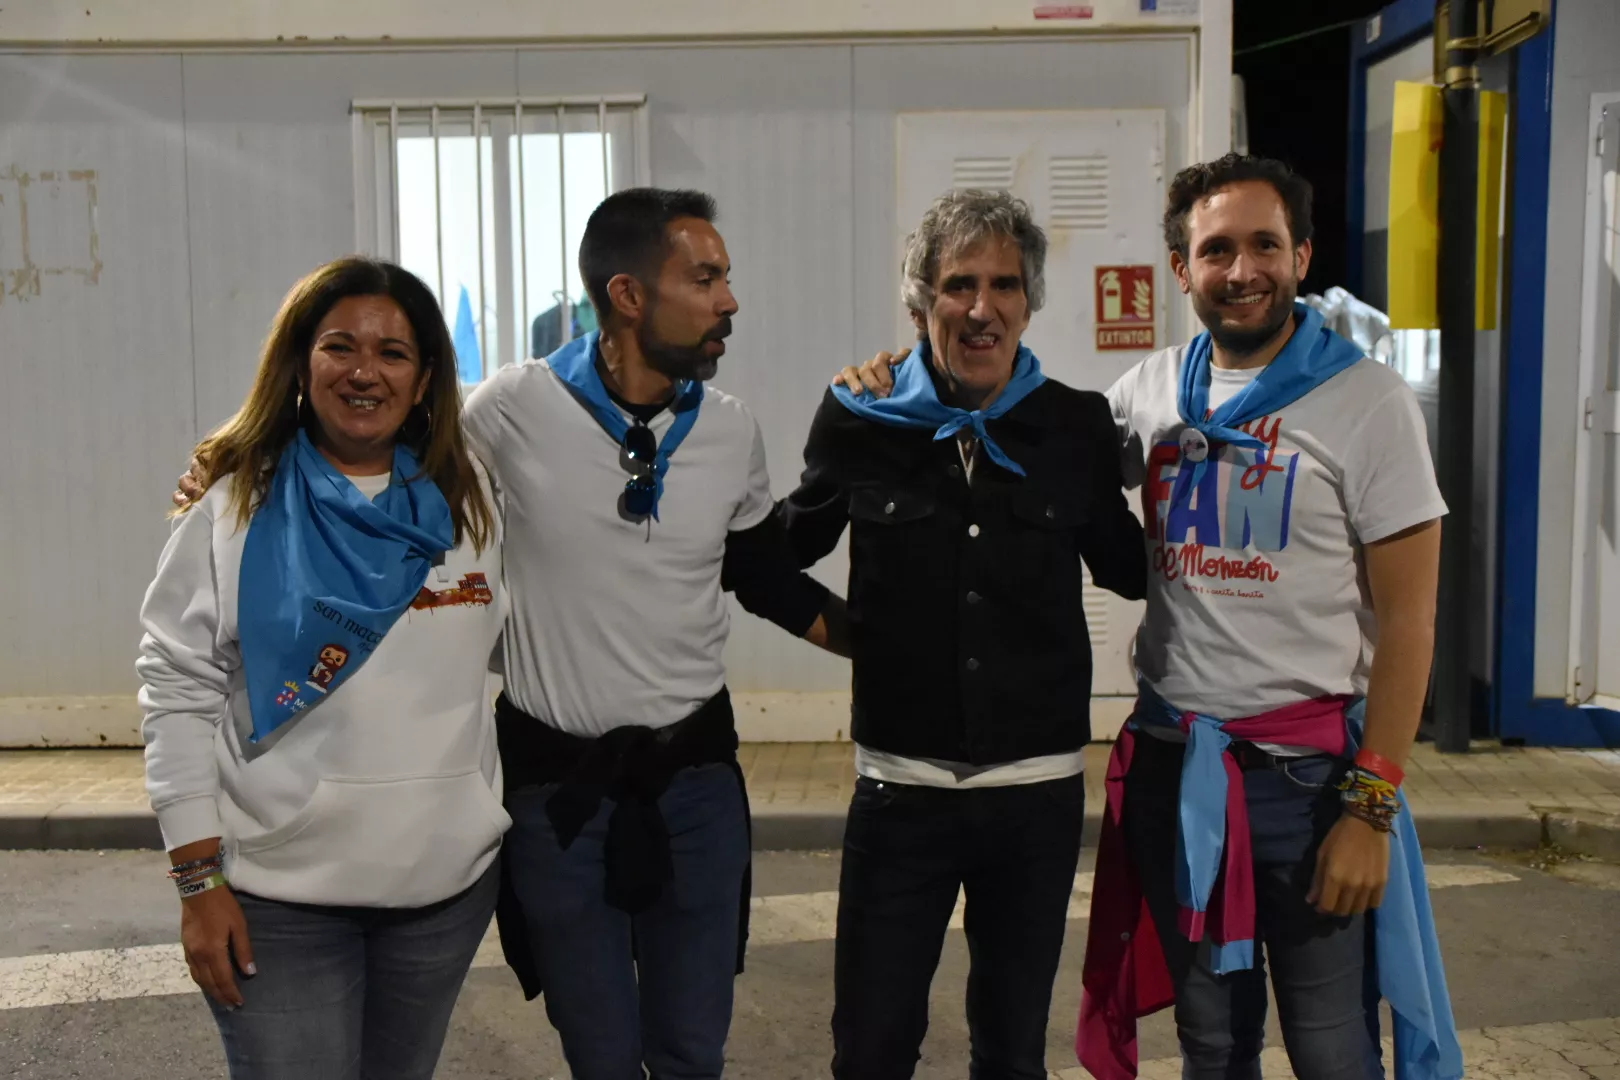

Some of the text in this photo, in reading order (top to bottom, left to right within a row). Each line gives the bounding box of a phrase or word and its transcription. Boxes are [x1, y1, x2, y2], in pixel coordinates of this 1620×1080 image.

[1099, 330, 1152, 345] EXTINTOR
[1141, 441, 1301, 553] FAN
[1152, 514, 1179, 582] de
